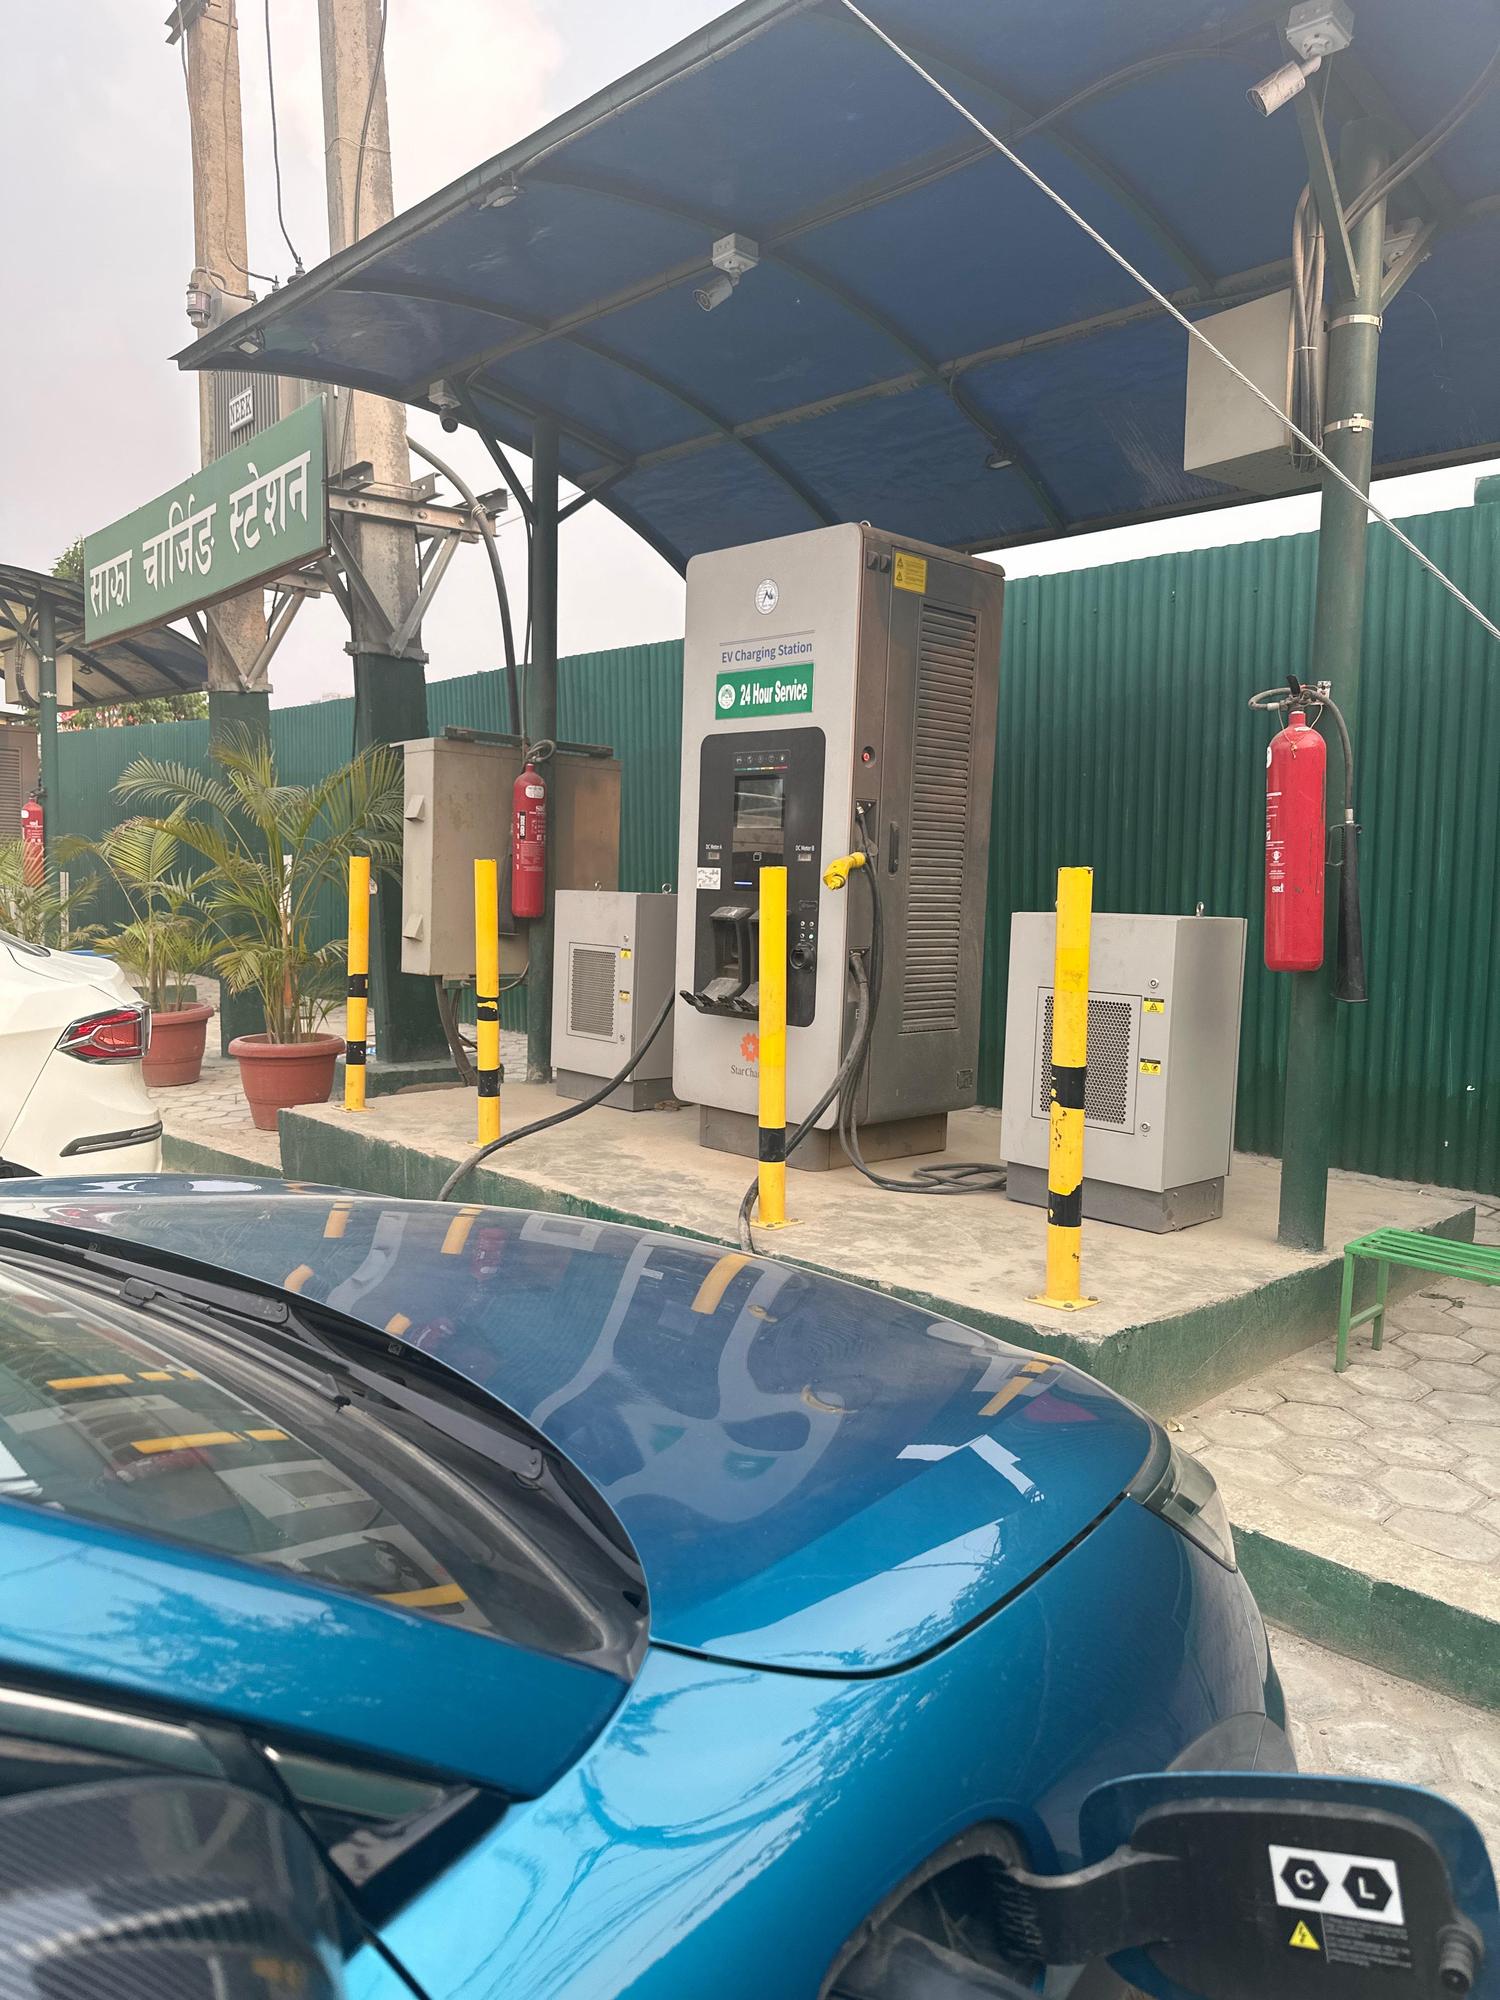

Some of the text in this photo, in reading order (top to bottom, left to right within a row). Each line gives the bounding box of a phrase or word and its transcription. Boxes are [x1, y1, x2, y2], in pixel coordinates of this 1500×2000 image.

[142, 493, 217, 592] चार्जिङ
[229, 450, 311, 554] स्टेशन
[721, 641, 812, 663] EV Charging Station
[740, 678, 808, 706] 24 Hour Service
[1295, 1868, 1377, 1900] C L
